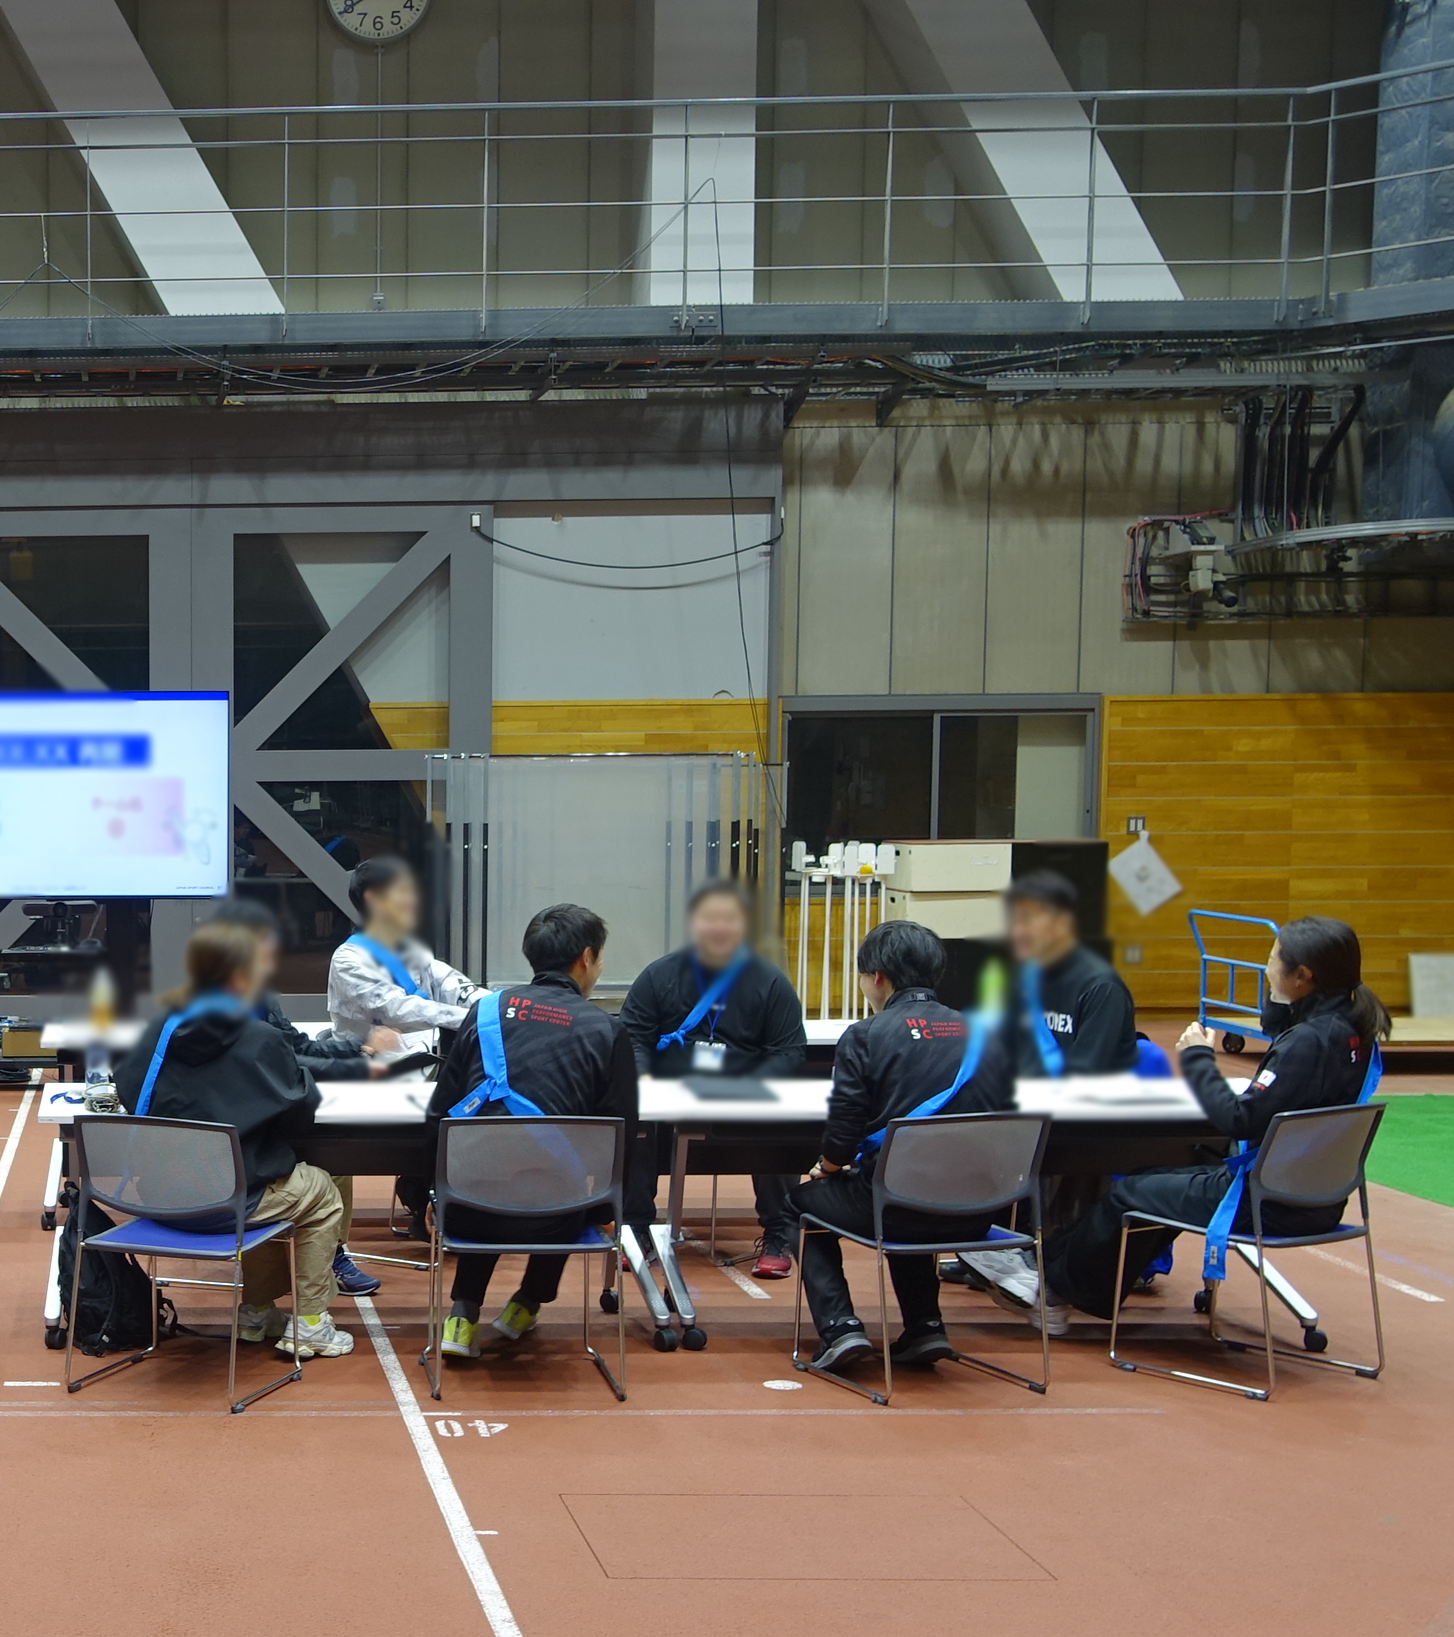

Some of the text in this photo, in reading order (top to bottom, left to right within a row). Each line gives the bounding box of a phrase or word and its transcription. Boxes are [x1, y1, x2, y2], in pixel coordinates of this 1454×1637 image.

[403, 0, 415, 11] 4
[357, 12, 368, 27] 7
[372, 15, 384, 31] 6
[390, 10, 402, 26] 5
[508, 996, 532, 1009] HP
[533, 1003, 553, 1011] JAPAN
[505, 1007, 529, 1021] SC
[905, 1018, 928, 1028] HP
[1044, 1011, 1074, 1035] ONEX
[910, 1028, 934, 1040] SC
[434, 1419, 509, 1438] 40
